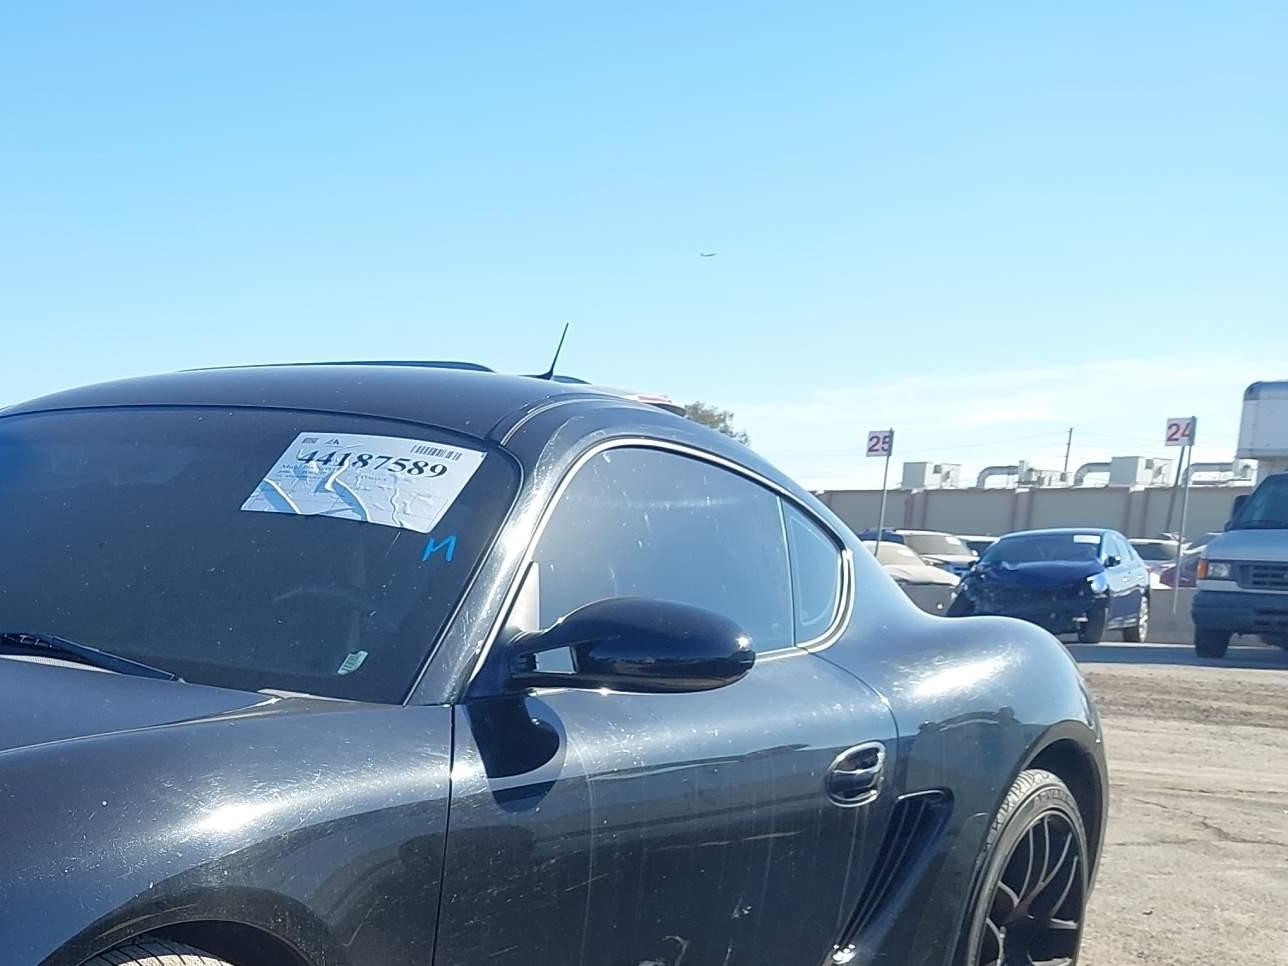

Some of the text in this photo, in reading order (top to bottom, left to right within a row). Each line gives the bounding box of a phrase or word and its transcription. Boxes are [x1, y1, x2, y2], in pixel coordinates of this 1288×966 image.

[1167, 422, 1193, 441] 24
[867, 435, 890, 452] 25
[296, 450, 449, 478] 44187589
